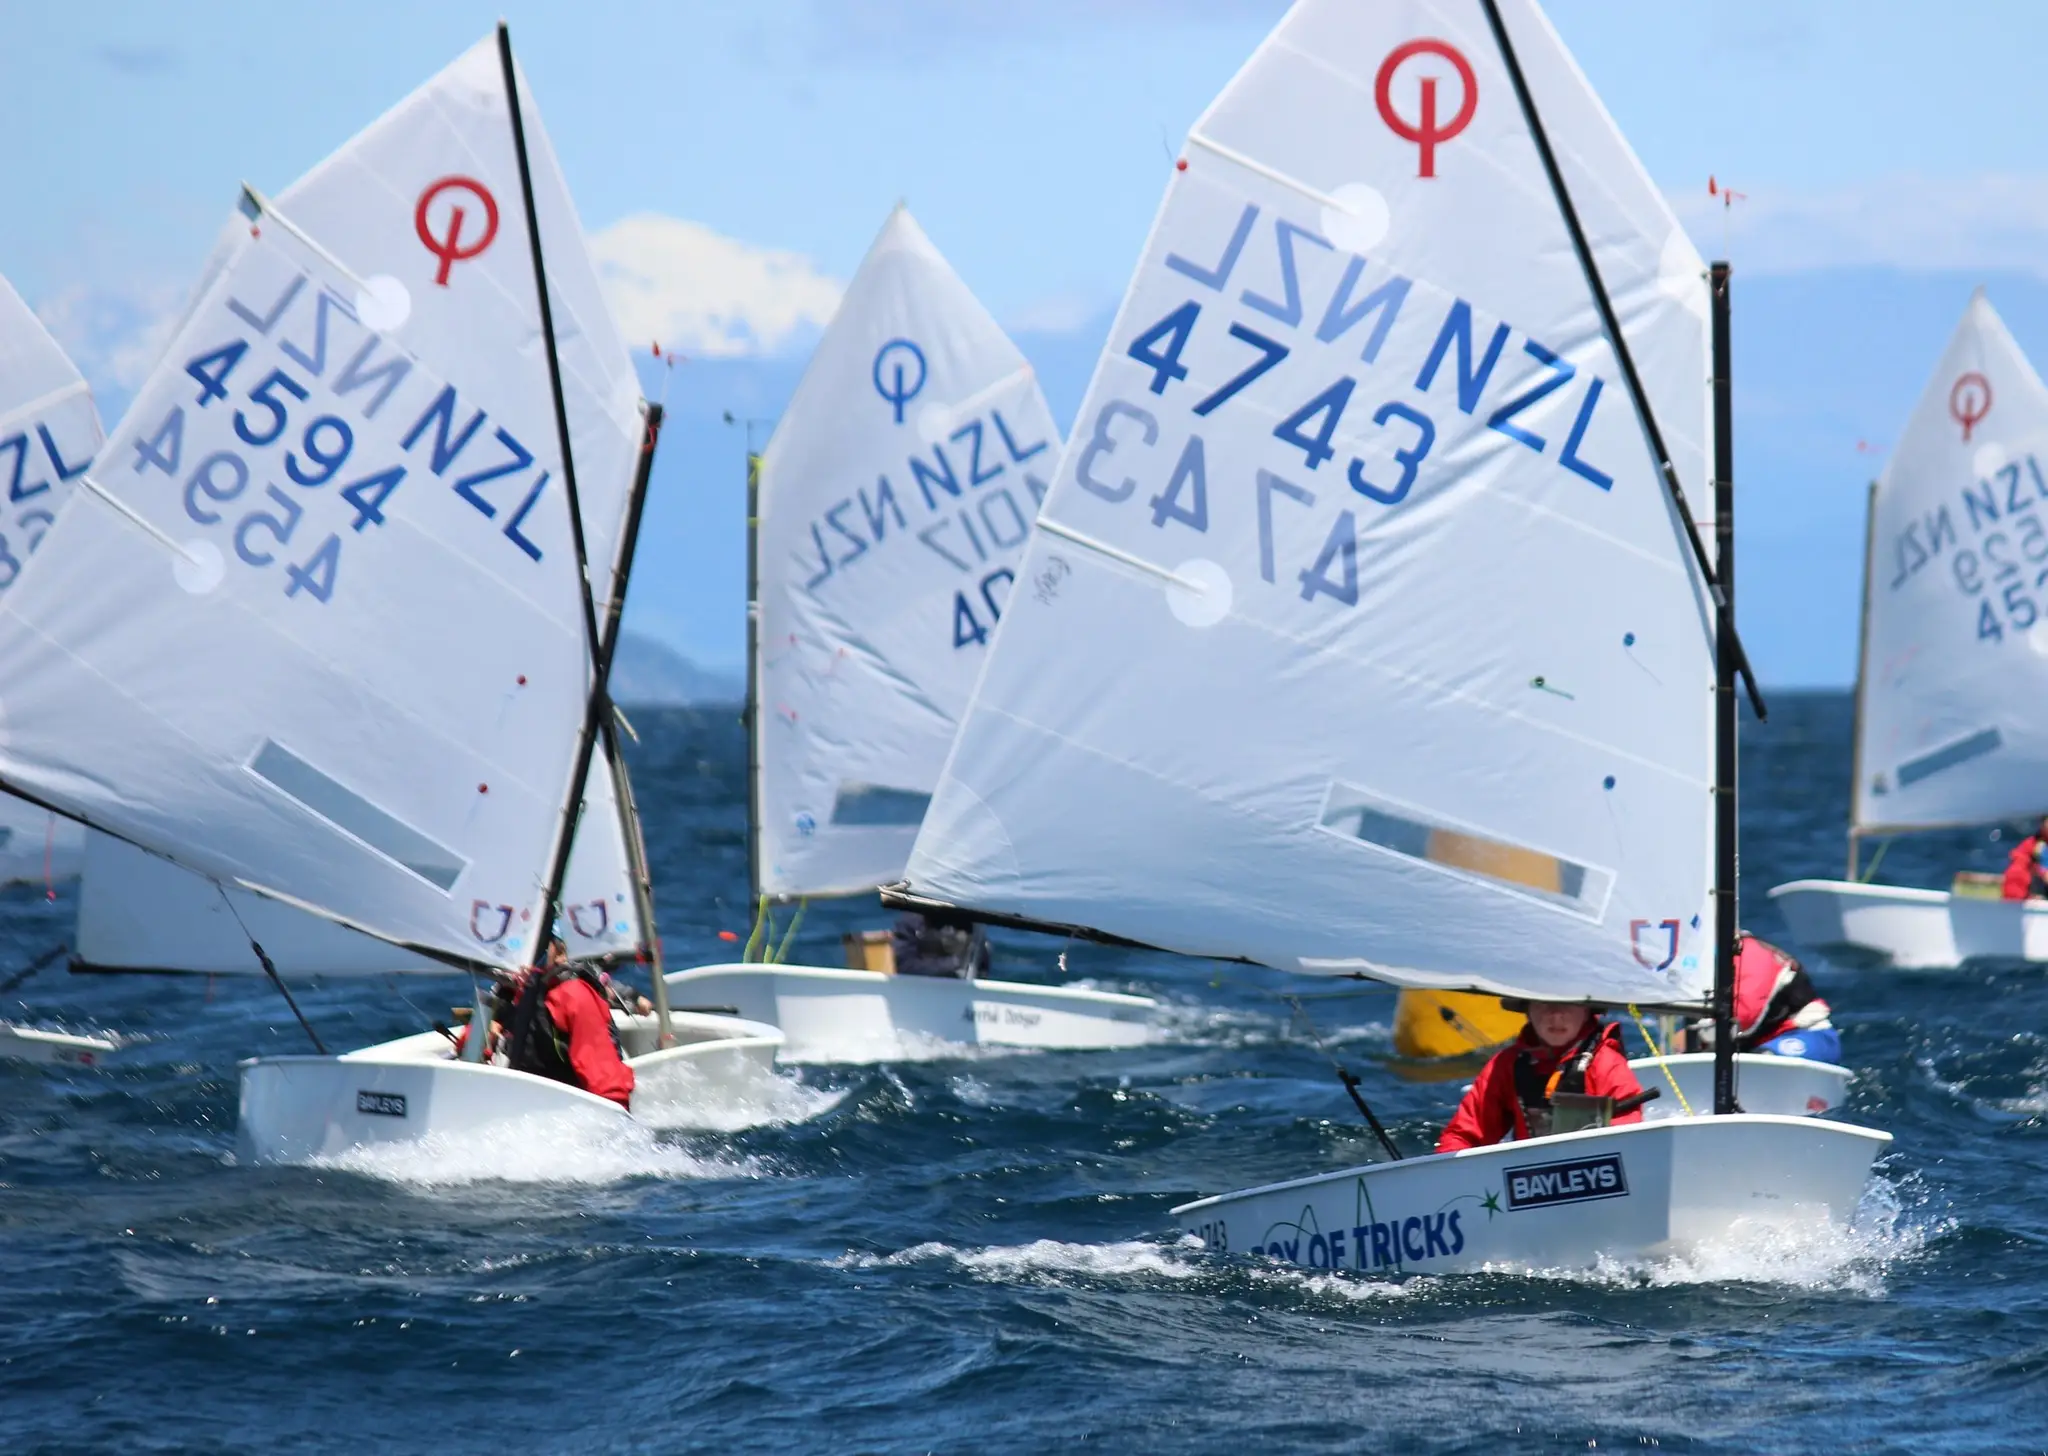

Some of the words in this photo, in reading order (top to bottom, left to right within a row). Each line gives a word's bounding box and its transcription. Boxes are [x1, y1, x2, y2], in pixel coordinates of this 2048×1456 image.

[184, 338, 408, 533] 4594
[908, 409, 1048, 511] NZL
[1127, 299, 1436, 505] 4743
[1414, 297, 1614, 492] NZL
[399, 382, 550, 563] NZL
[359, 1094, 405, 1114] BAYLEYS
[1308, 1229, 1346, 1269] OF
[1352, 1209, 1465, 1270] TRICKS
[1513, 1164, 1617, 1200] BAYLEYS
